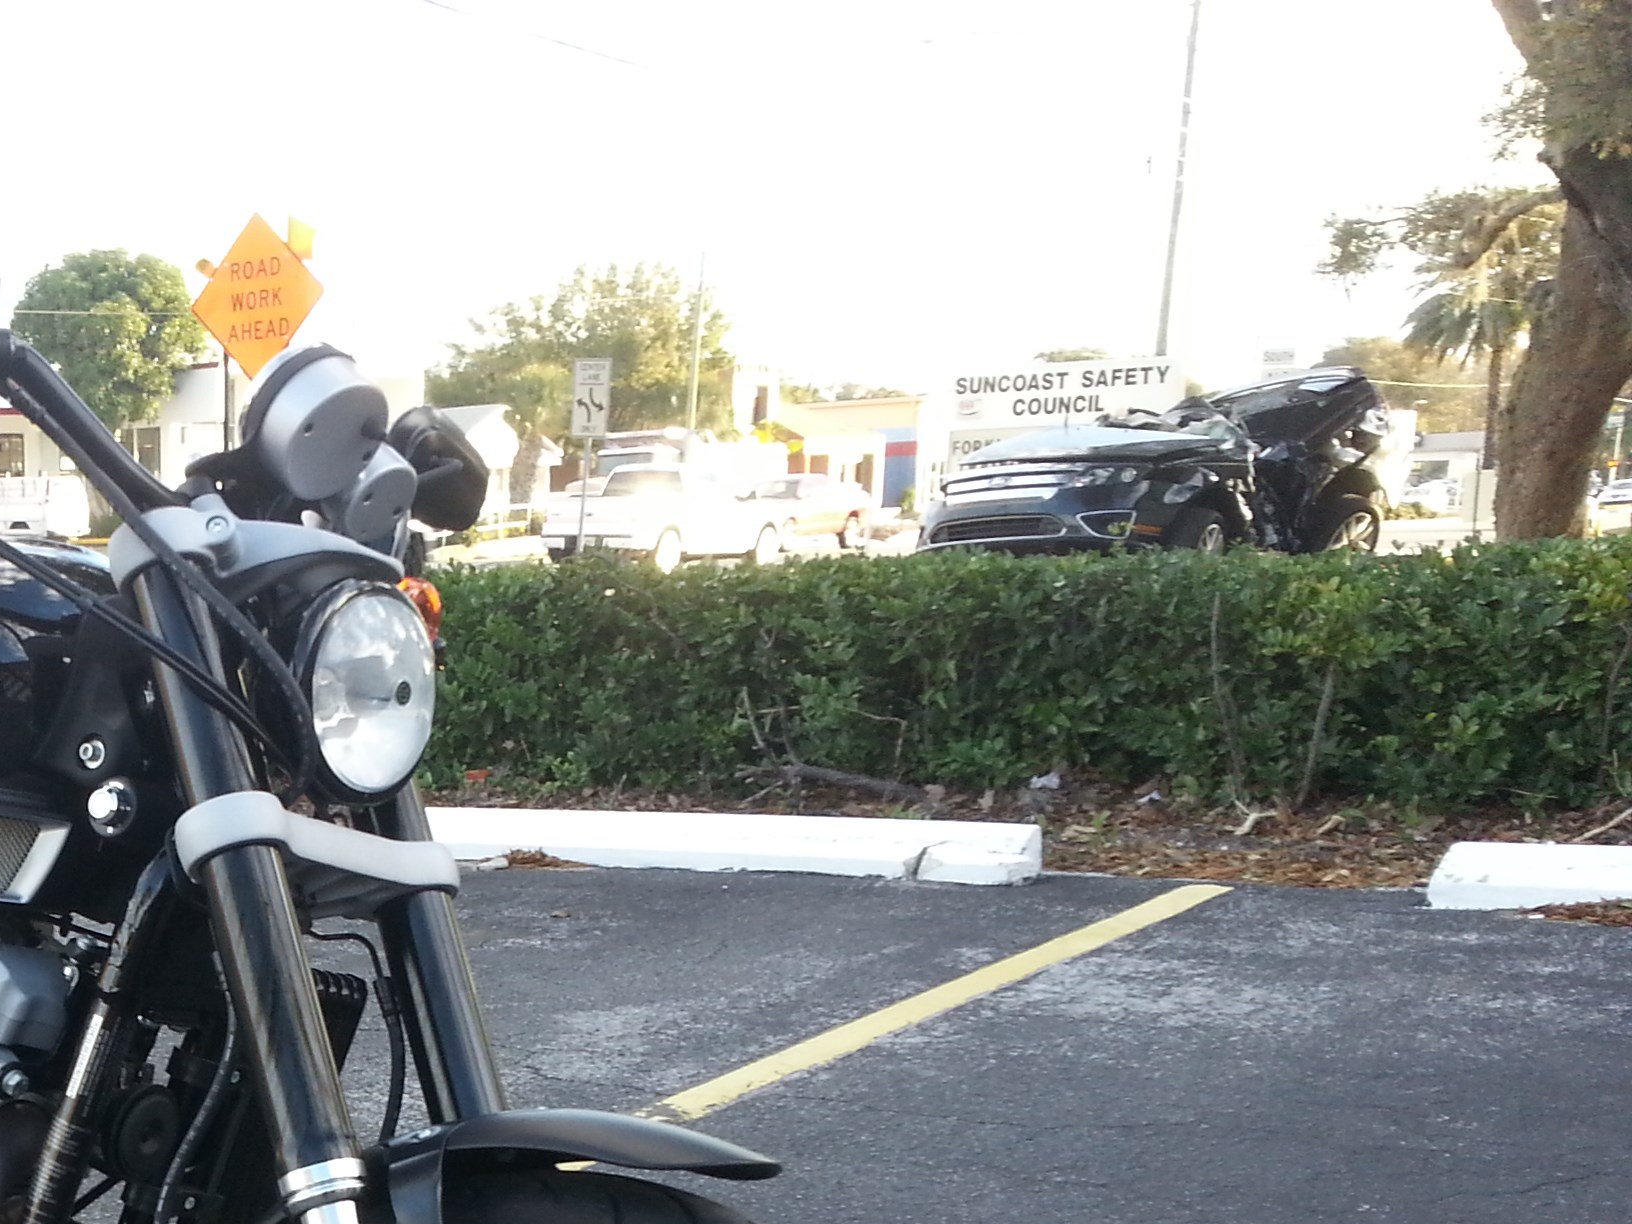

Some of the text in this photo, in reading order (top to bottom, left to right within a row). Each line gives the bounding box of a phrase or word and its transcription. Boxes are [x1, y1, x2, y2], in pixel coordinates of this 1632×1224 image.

[230, 256, 281, 281] ROAD
[231, 287, 283, 313] WORK
[228, 317, 290, 343] AHEAD
[955, 365, 1170, 396] SUNCOAST SAFETY
[1012, 394, 1105, 417] COUNCIL
